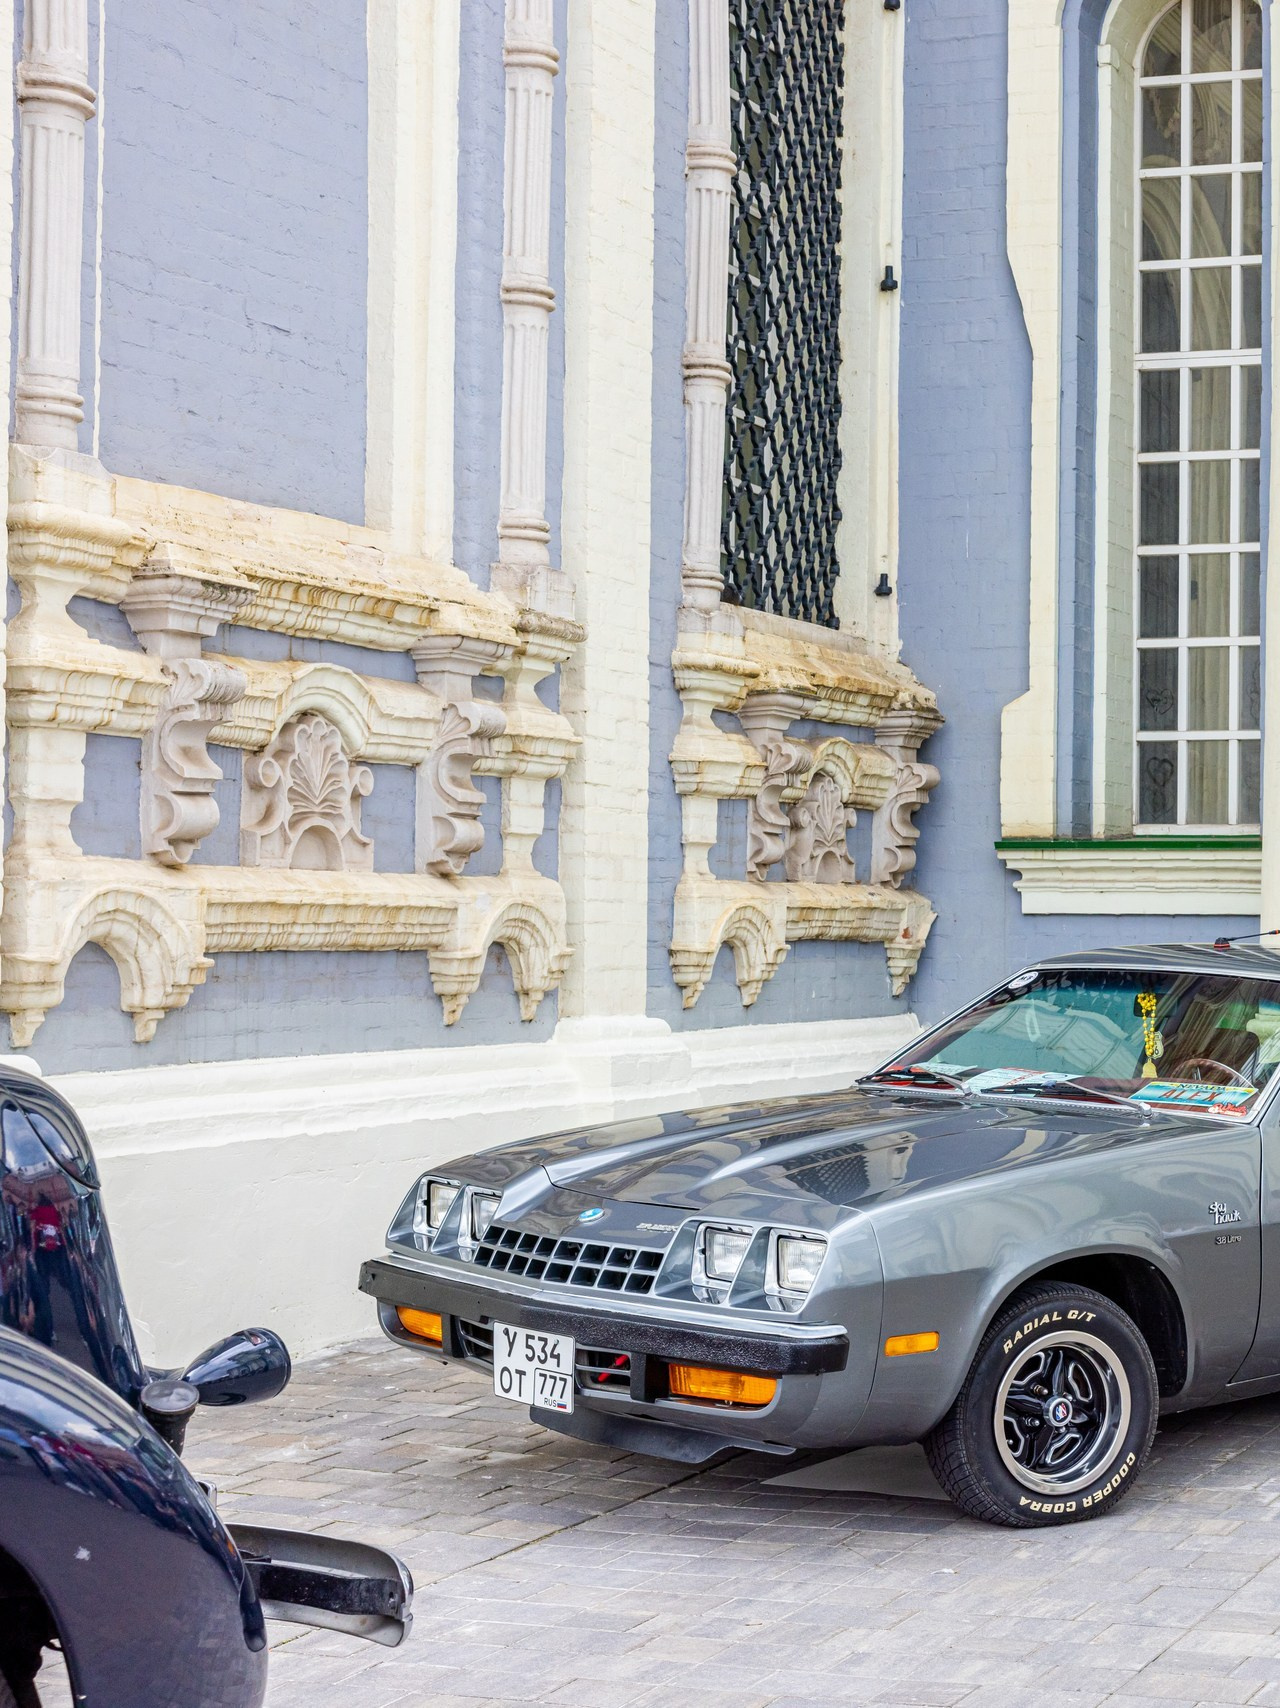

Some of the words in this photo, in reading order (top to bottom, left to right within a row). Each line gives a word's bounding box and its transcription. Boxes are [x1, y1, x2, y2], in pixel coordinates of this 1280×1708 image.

[1160, 1088, 1222, 1102] ALEX
[1002, 1311, 1063, 1354] RADIAL
[1067, 1309, 1097, 1323] G/T
[525, 1333, 561, 1368] 534
[539, 1372, 568, 1399] 777
[544, 1398, 557, 1408] RUS
[1082, 1451, 1137, 1508] COOPER
[1018, 1495, 1078, 1514] COBRA
